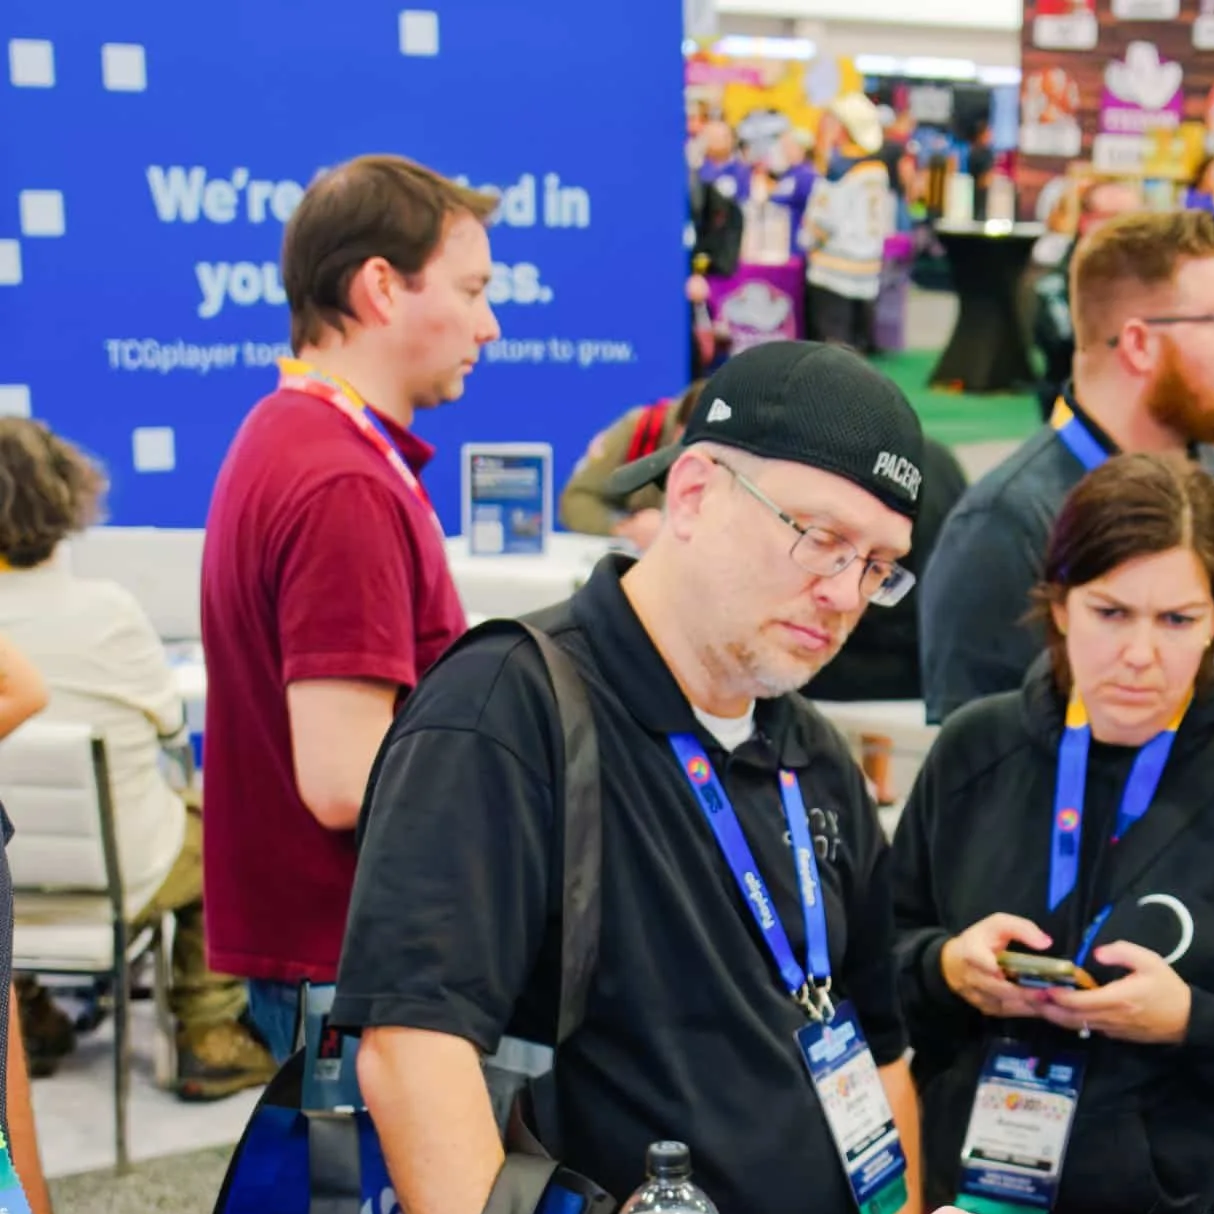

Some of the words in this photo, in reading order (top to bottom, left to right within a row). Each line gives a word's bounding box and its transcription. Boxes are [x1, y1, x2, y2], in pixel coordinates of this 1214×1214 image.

[543, 172, 591, 229] in
[194, 261, 287, 319] you
[105, 337, 238, 374] TCGplayer
[872, 451, 922, 501] PACERS
